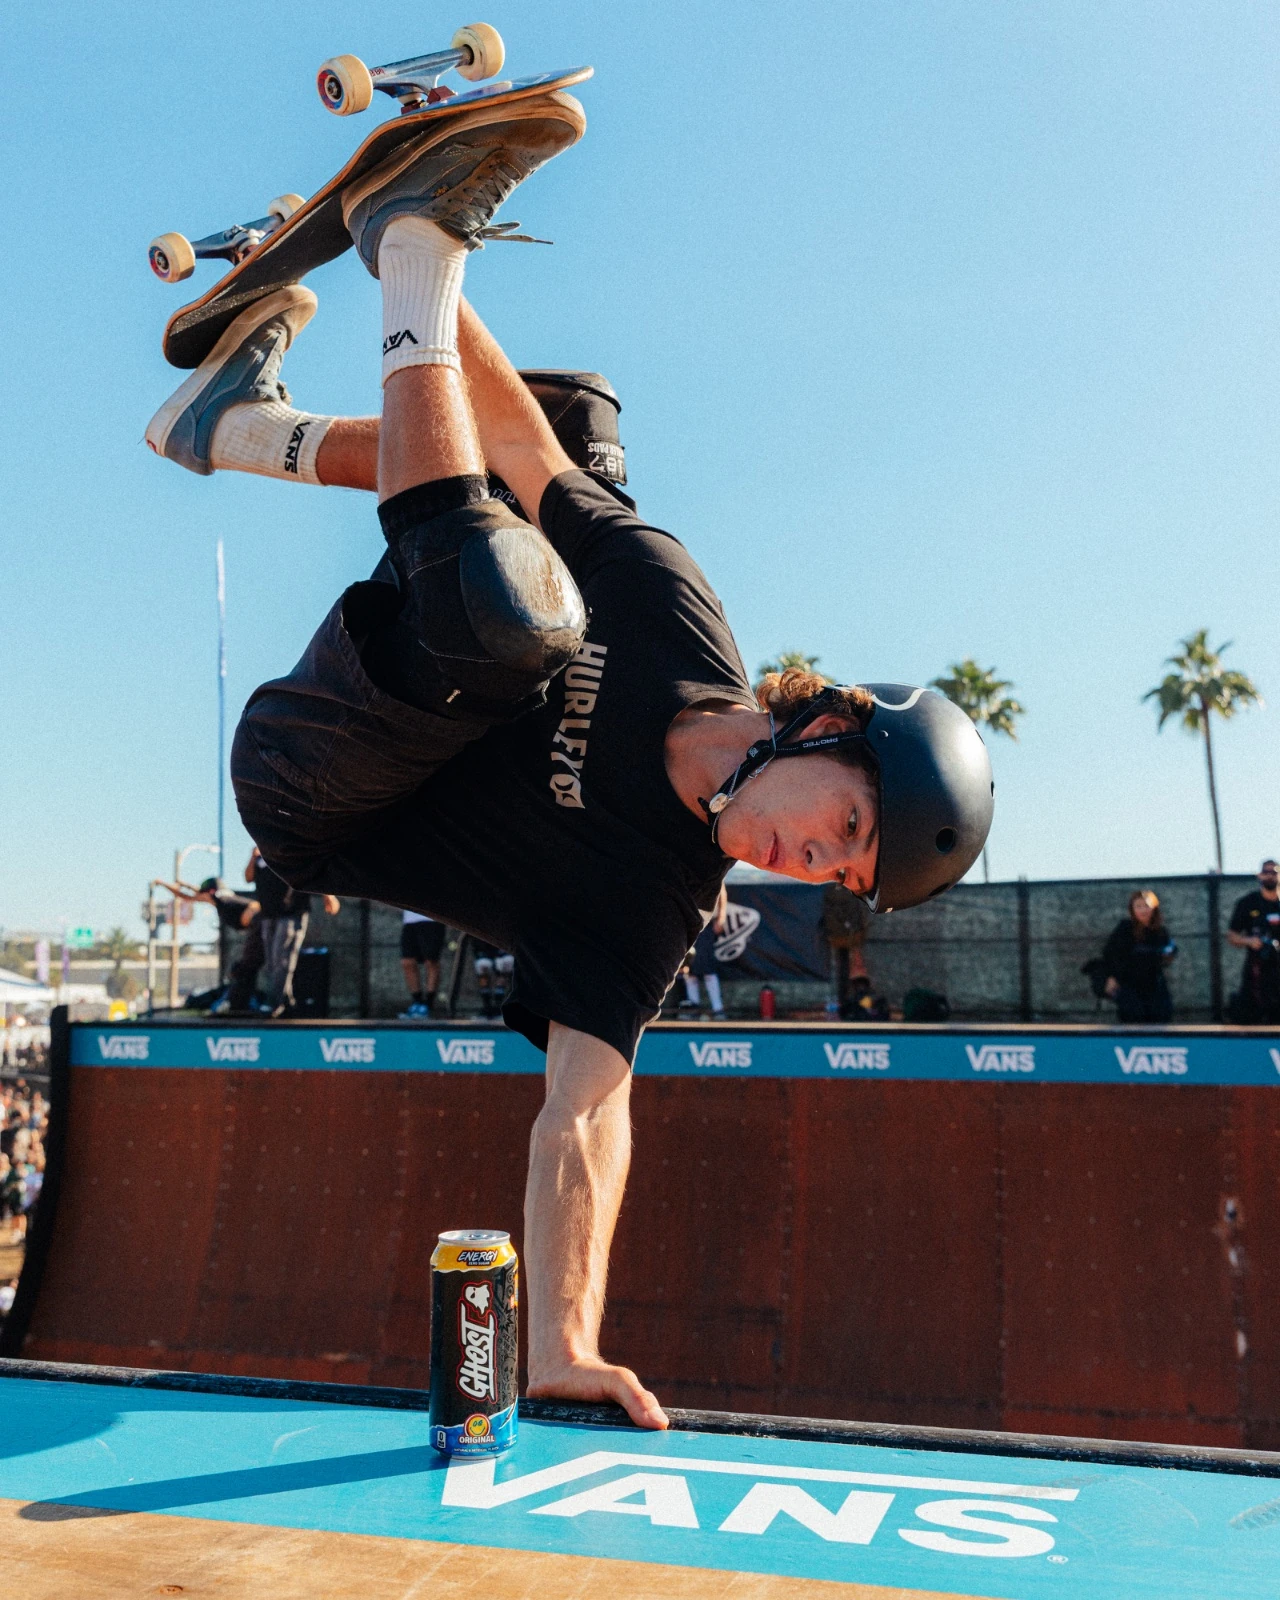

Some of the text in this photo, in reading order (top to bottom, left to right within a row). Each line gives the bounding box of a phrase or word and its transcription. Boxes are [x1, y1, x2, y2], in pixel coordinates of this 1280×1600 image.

[284, 421, 311, 474] VANS
[587, 442, 609, 454] PADS
[551, 641, 608, 780] HURLEY
[98, 1035, 150, 1060] VANS
[206, 1037, 260, 1061] VANS
[319, 1038, 376, 1063] VANS
[436, 1039, 495, 1065] VANS
[689, 1041, 752, 1068] VANS
[823, 1042, 890, 1070] VANS
[965, 1044, 1035, 1072] VANS
[1114, 1046, 1188, 1075] VANS
[457, 1250, 498, 1262] ENERGY
[459, 1302, 496, 1400] GHOST
[459, 1435, 495, 1444] ORIGINAL
[441, 1450, 1080, 1558] VANS
